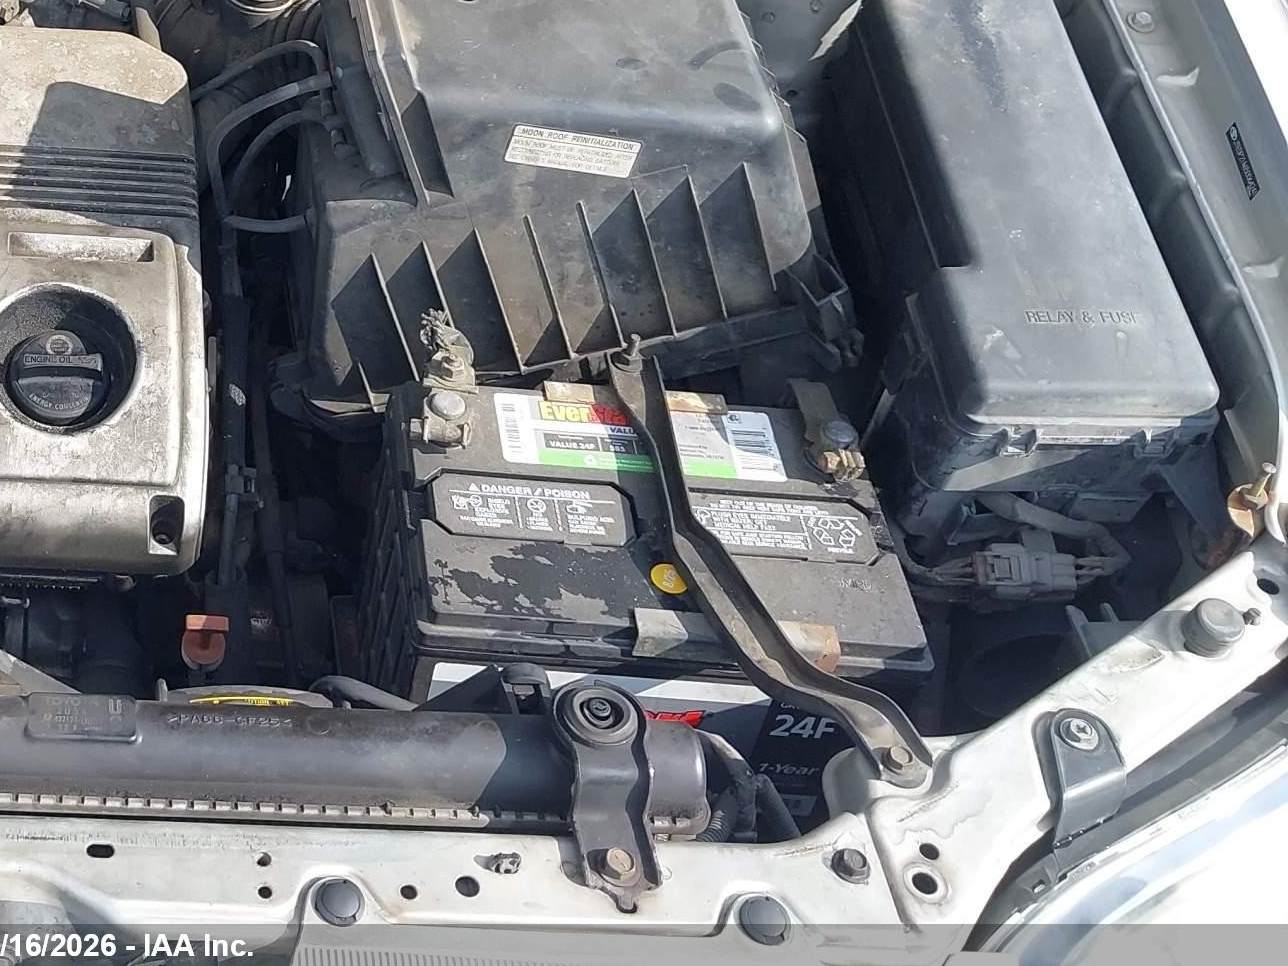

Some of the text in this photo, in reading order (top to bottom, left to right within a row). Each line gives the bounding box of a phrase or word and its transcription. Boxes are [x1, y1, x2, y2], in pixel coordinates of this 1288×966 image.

[521, 128, 634, 150] MOON ROOF REINITIALIZATION
[1025, 310, 1073, 323] RELAY
[1080, 310, 1094, 324] &
[58, 355, 73, 364] OIL
[28, 393, 53, 409] ENERGY
[548, 440, 578, 449] VALUE
[481, 484, 534, 496] DANGER
[545, 489, 590, 500] POISON
[769, 714, 838, 739] 24F
[759, 762, 819, 776] 1-Year
